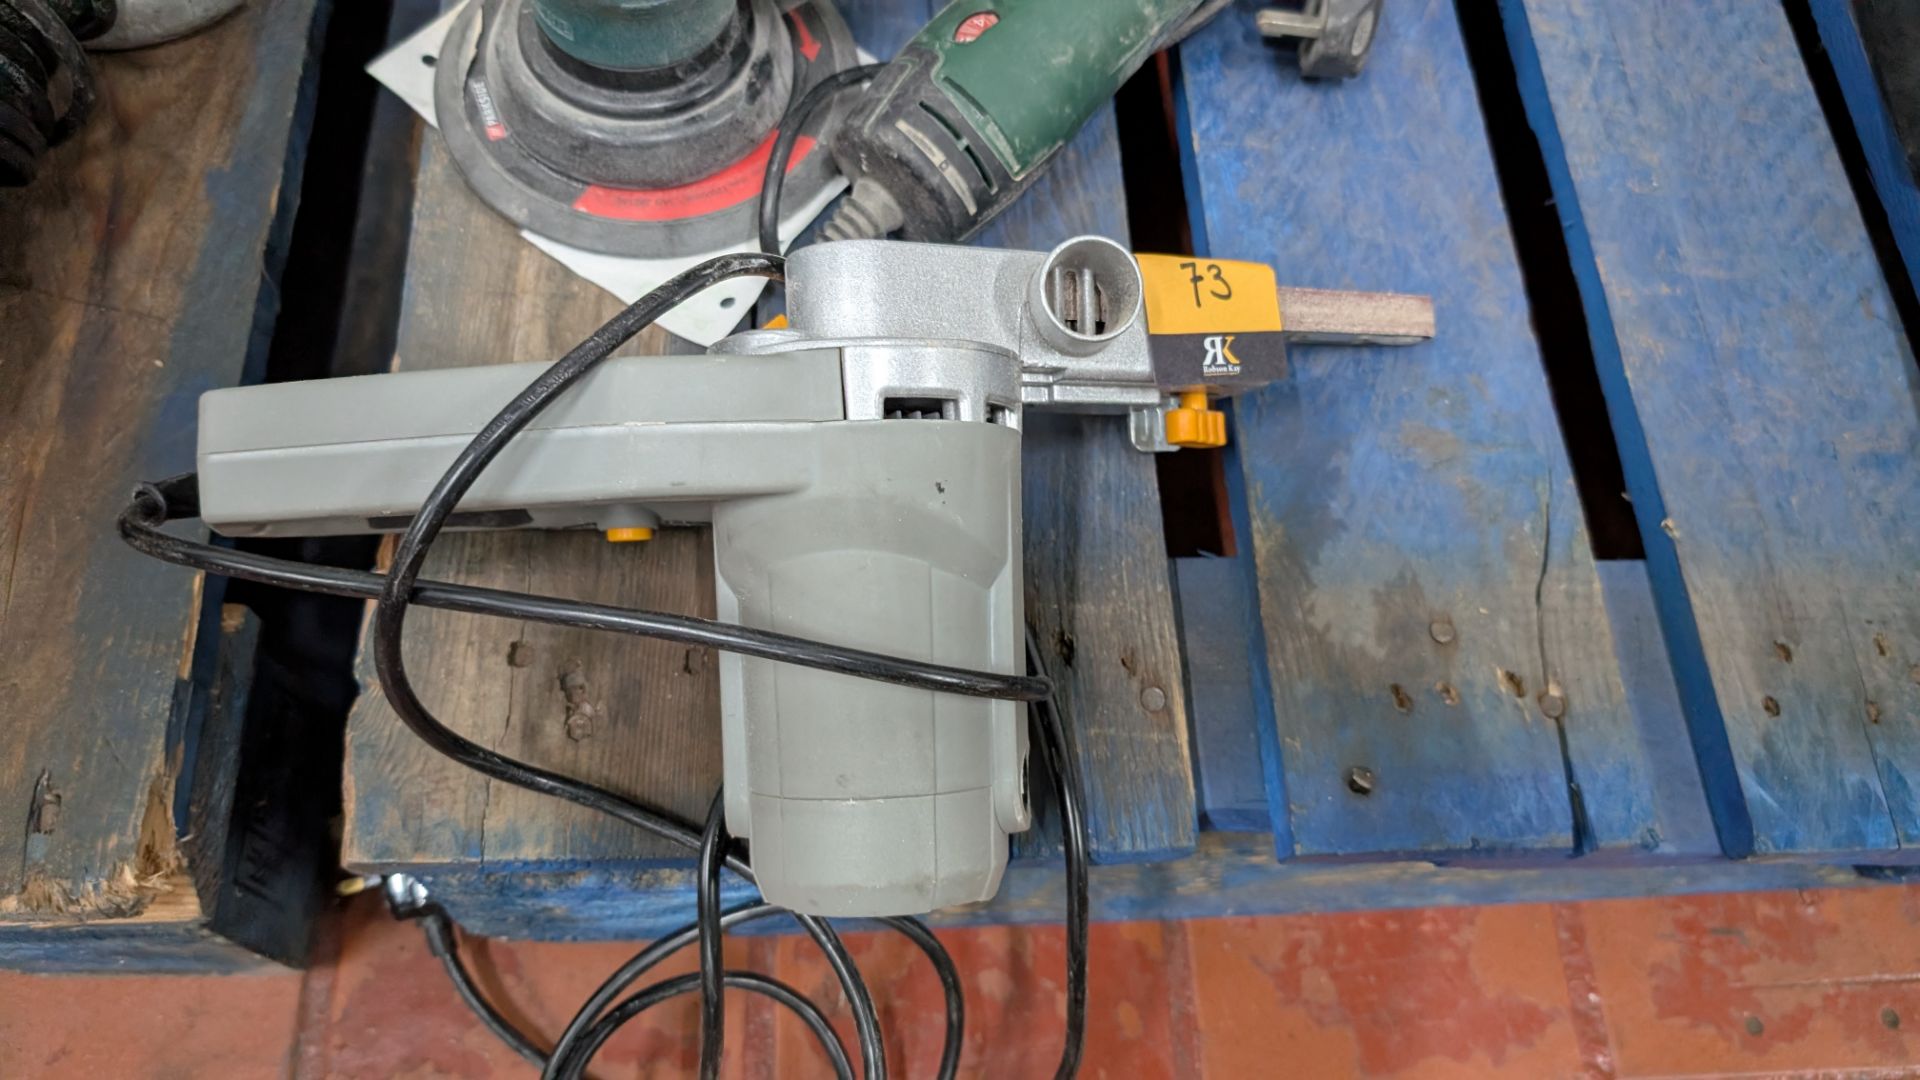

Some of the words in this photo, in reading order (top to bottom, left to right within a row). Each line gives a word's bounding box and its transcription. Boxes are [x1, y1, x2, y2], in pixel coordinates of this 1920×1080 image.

[472, 80, 498, 126] PARKSIDE
[1180, 262, 1232, 308] 73
[1203, 365, 1227, 373] Robson
[1228, 364, 1241, 374] Kay
